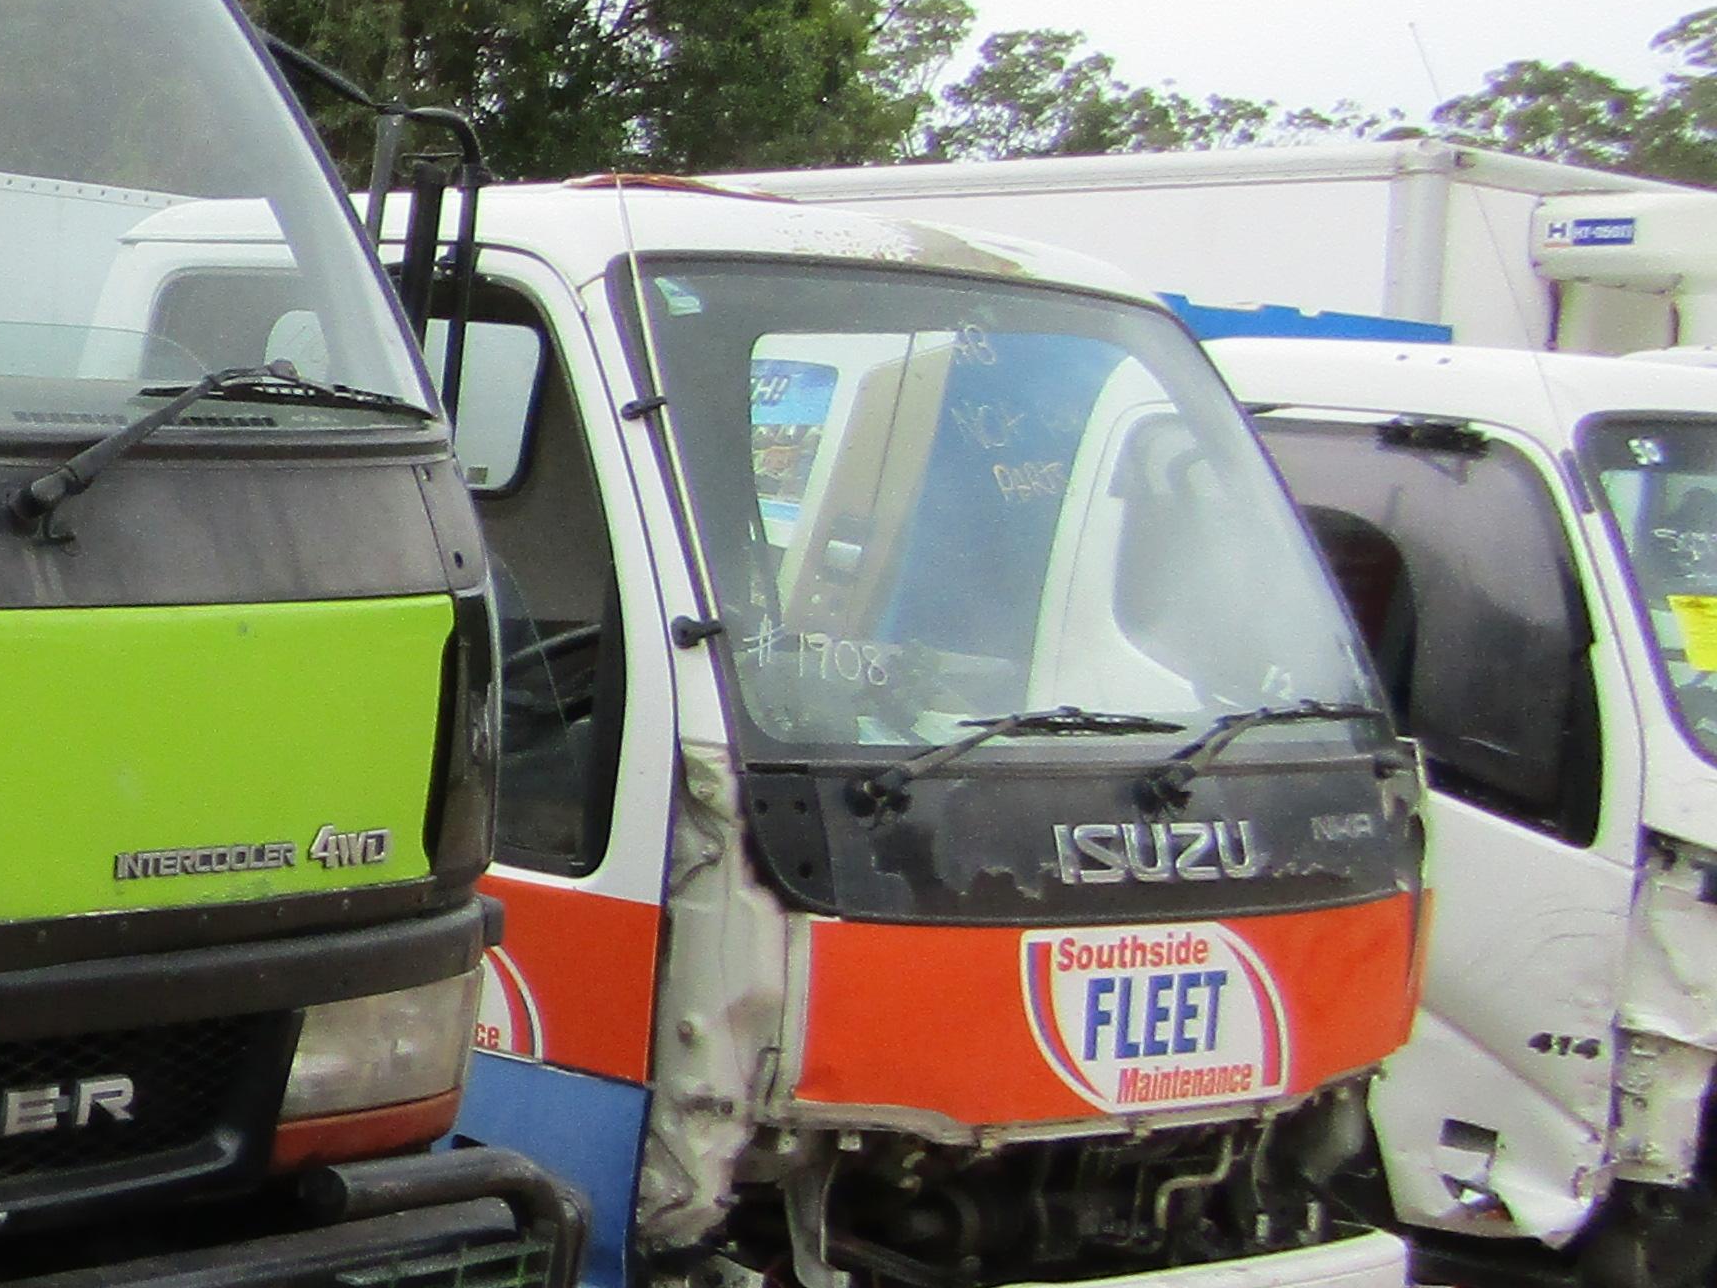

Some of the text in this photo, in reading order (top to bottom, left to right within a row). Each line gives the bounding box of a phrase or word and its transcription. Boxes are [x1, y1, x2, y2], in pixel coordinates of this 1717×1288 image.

[115, 823, 390, 880] INTERCOOLER 4WD
[1052, 819, 1255, 885] ISUZU
[1057, 931, 1209, 972] Southside
[1083, 970, 1228, 1062] FLEET
[1117, 1064, 1253, 1105] Maintenance
